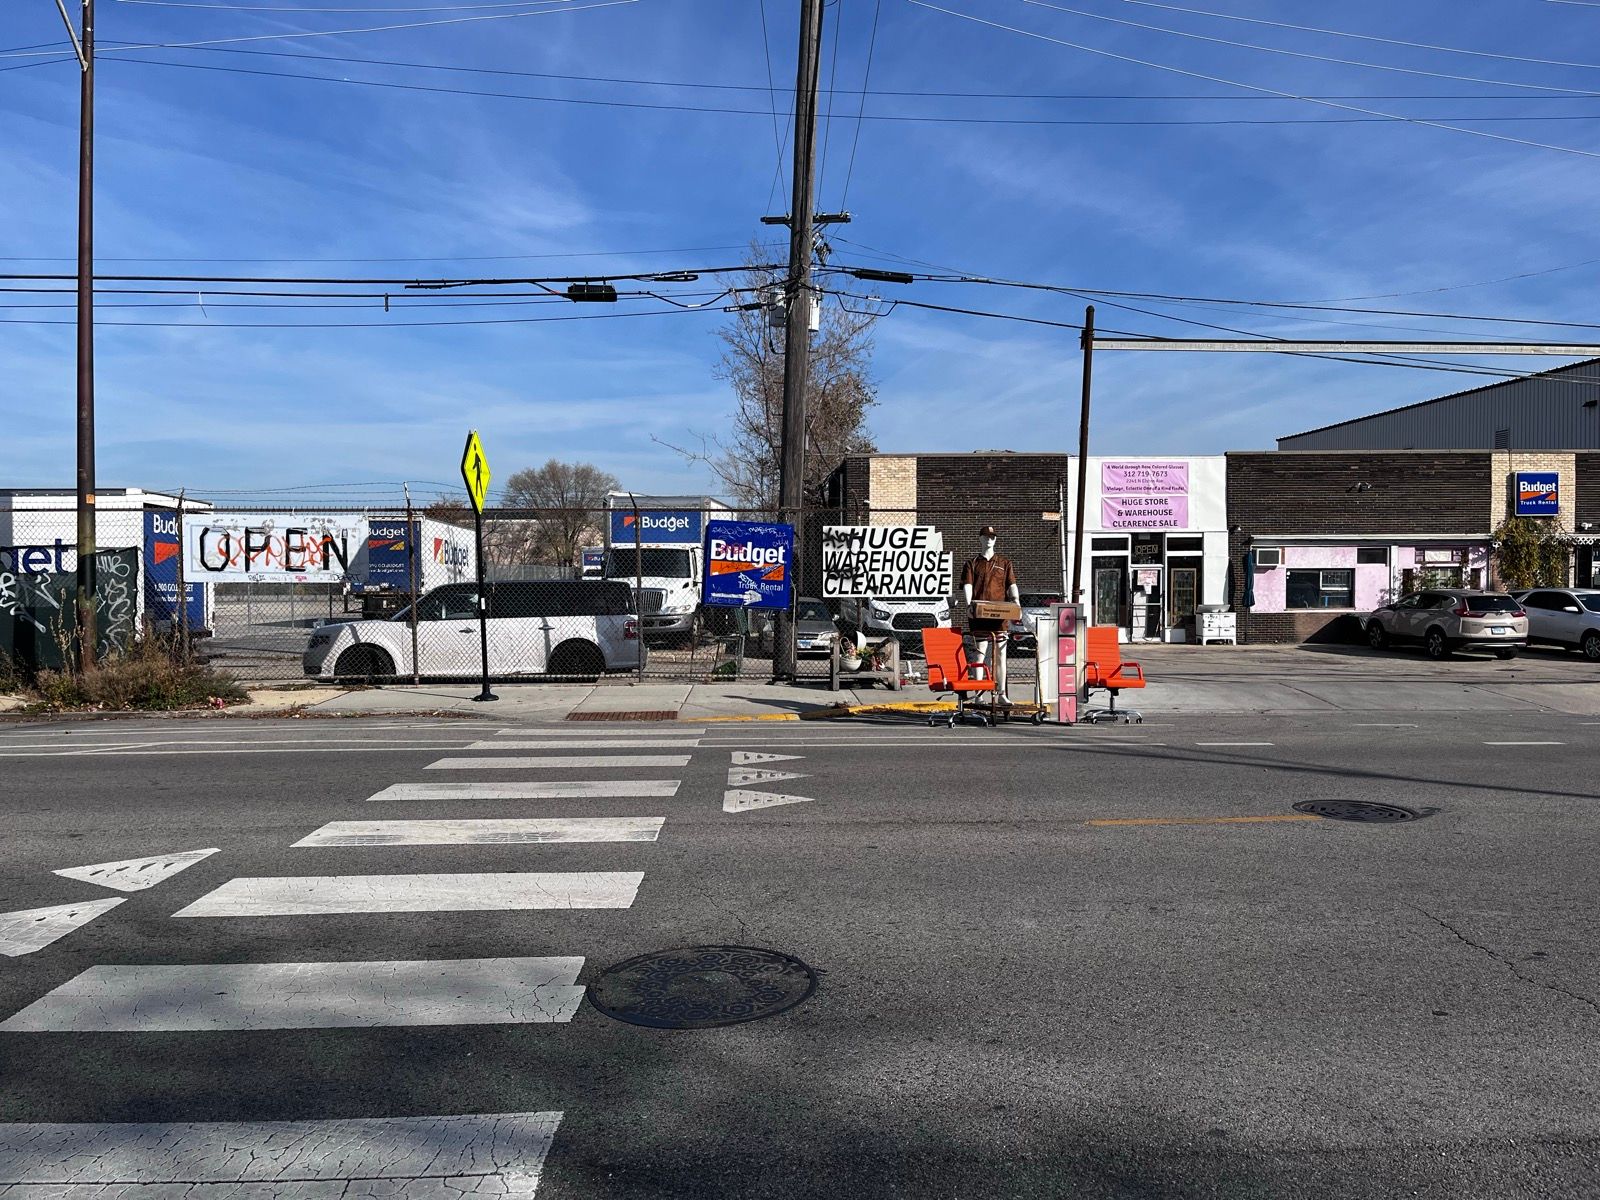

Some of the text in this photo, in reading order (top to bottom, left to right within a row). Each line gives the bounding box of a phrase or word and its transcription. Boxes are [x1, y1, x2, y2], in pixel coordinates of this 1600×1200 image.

[1520, 481, 1557, 494] Budget
[642, 516, 690, 532] Budget
[847, 528, 928, 549] HUGE
[199, 527, 348, 572] OPEN
[711, 539, 786, 567] Budget
[824, 551, 949, 572] WAREHOUSE
[738, 581, 784, 592] Truck Rental
[824, 574, 952, 594] CLEARANCE
[1059, 608, 1077, 722] OPEN
